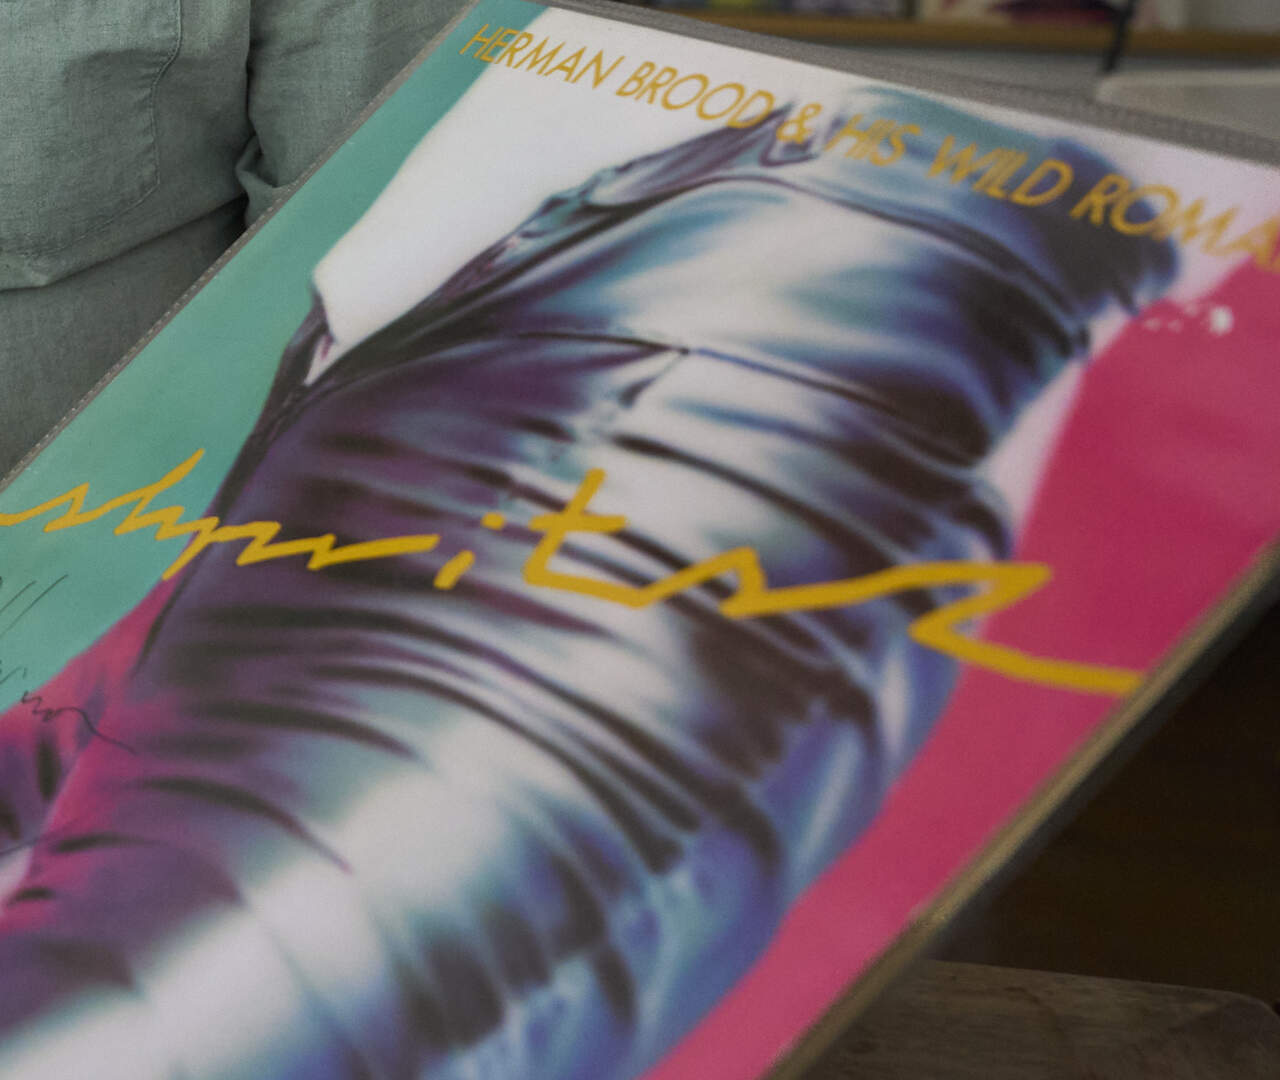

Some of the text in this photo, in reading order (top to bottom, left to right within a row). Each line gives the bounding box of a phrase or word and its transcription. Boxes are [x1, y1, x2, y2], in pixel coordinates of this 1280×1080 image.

[459, 23, 1280, 274] HERMAN BROOD & HIS WILD ROMA
